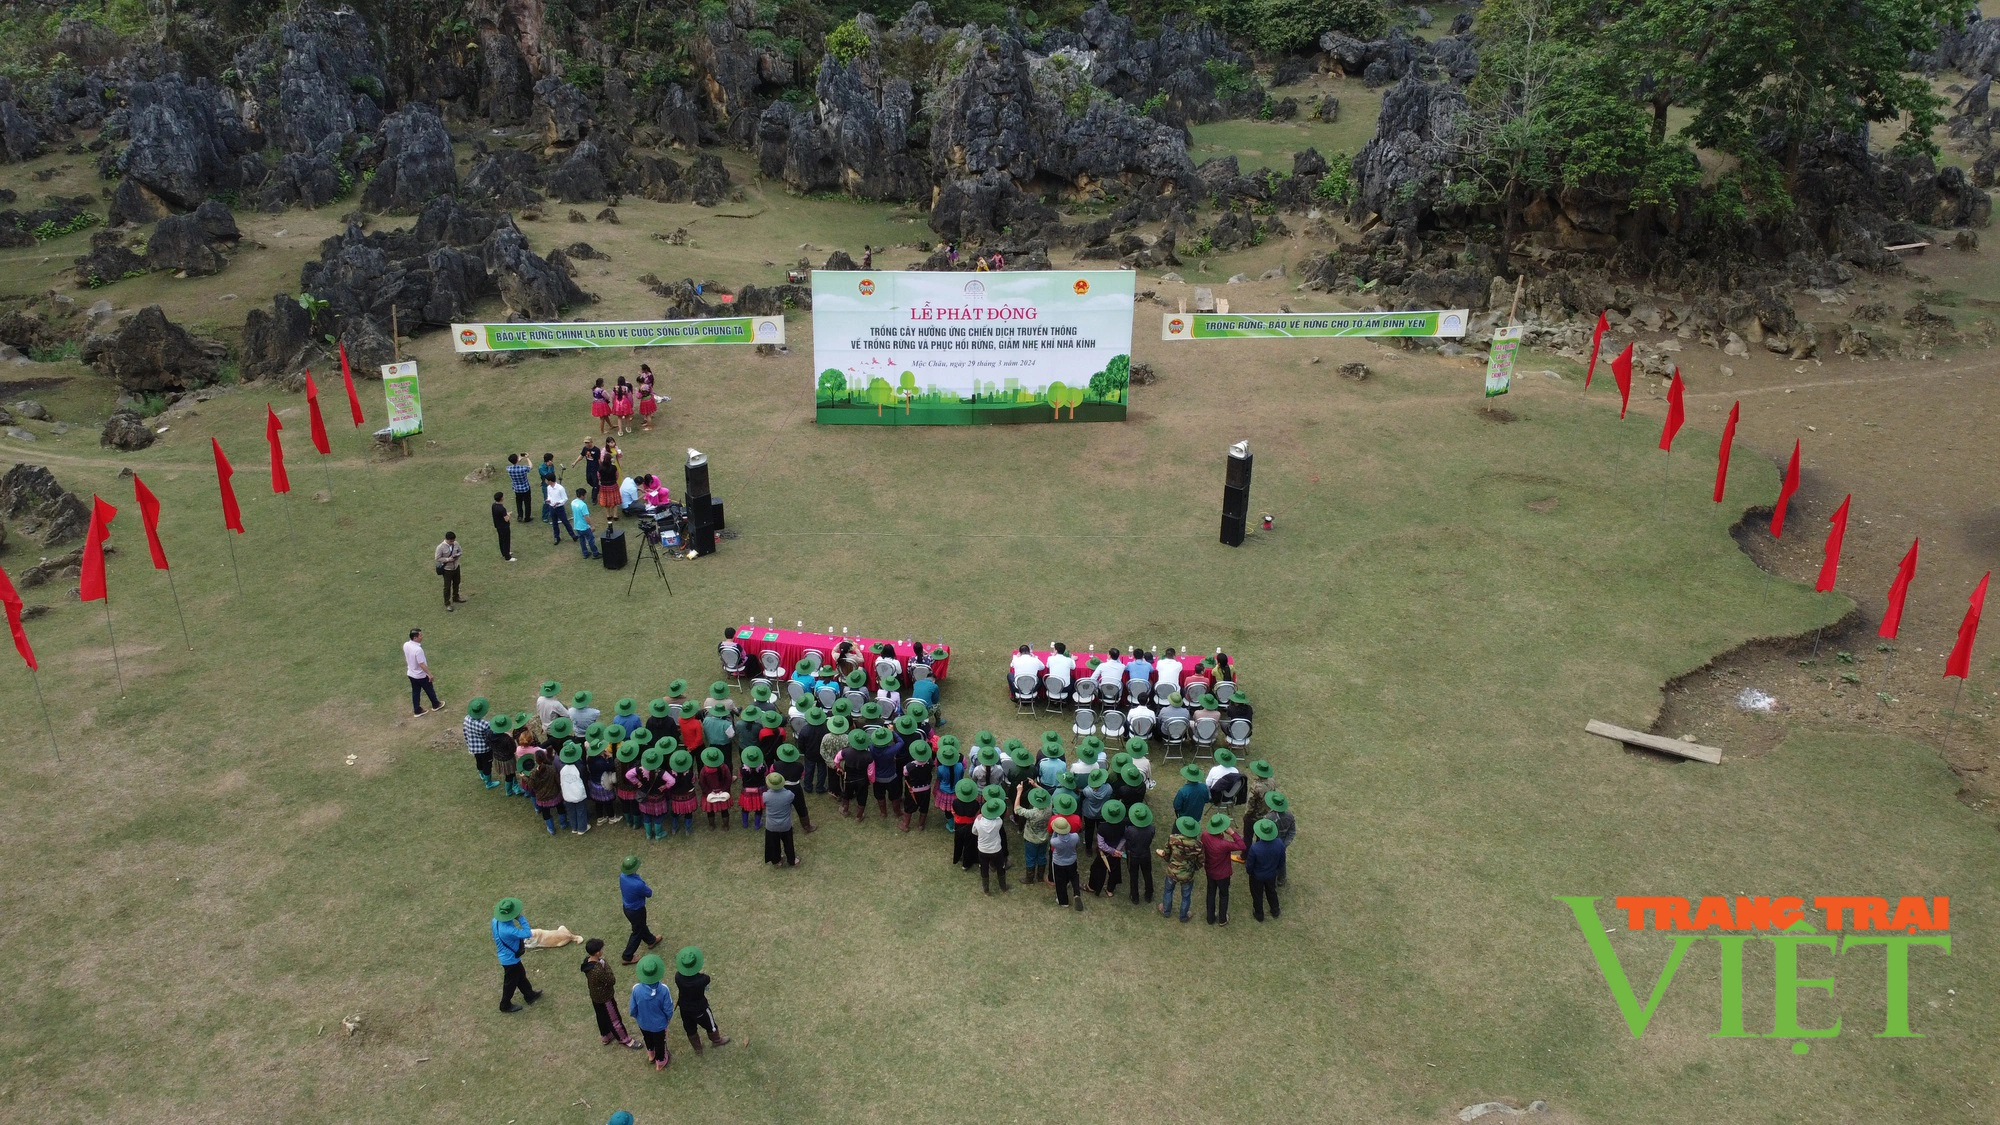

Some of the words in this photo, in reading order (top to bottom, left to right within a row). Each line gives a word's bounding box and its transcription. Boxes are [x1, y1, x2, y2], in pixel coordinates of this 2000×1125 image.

[910, 301, 933, 320] LỄ
[936, 304, 984, 320] PHÁT
[987, 303, 1038, 323] ĐỘNG
[1331, 319, 1349, 329] CHO
[1407, 318, 1425, 328] YÊN
[496, 329, 514, 341] BẢO
[516, 330, 527, 343] VỆ
[530, 329, 554, 341] RỪNG
[556, 327, 583, 340] CHÍNH
[598, 326, 615, 338] BẢO
[618, 327, 629, 340] VỆ
[657, 324, 680, 336] SỐNG
[683, 324, 700, 336] CỦA
[734, 325, 744, 335] TA
[870, 324, 898, 337] TRỒNG
[900, 325, 916, 337] CÂY
[918, 324, 947, 337] HƯỞNG
[948, 324, 966, 337] ỨNG
[968, 324, 993, 337] CHIẾN
[995, 327, 1015, 338] DỊCH
[1017, 324, 1048, 336] TRUYỀN
[1051, 324, 1078, 336] THÔNG
[851, 337, 862, 350] VỀ
[863, 337, 891, 350] TRỒNG
[893, 338, 916, 350] RỪNG
[918, 339, 929, 350] VÀ
[931, 340, 953, 352] PHỤC
[955, 337, 969, 350] HỒI
[998, 337, 1020, 349] GIẢM
[1022, 339, 1039, 351] NHẸ
[1041, 337, 1055, 349] KHÍ
[1056, 338, 1074, 349] NHÀ
[1076, 337, 1096, 349] KÍNH
[911, 360, 927, 368] Mộc
[928, 360, 948, 368] Châu,
[949, 361, 966, 369] ngày
[976, 360, 996, 368] tháng
